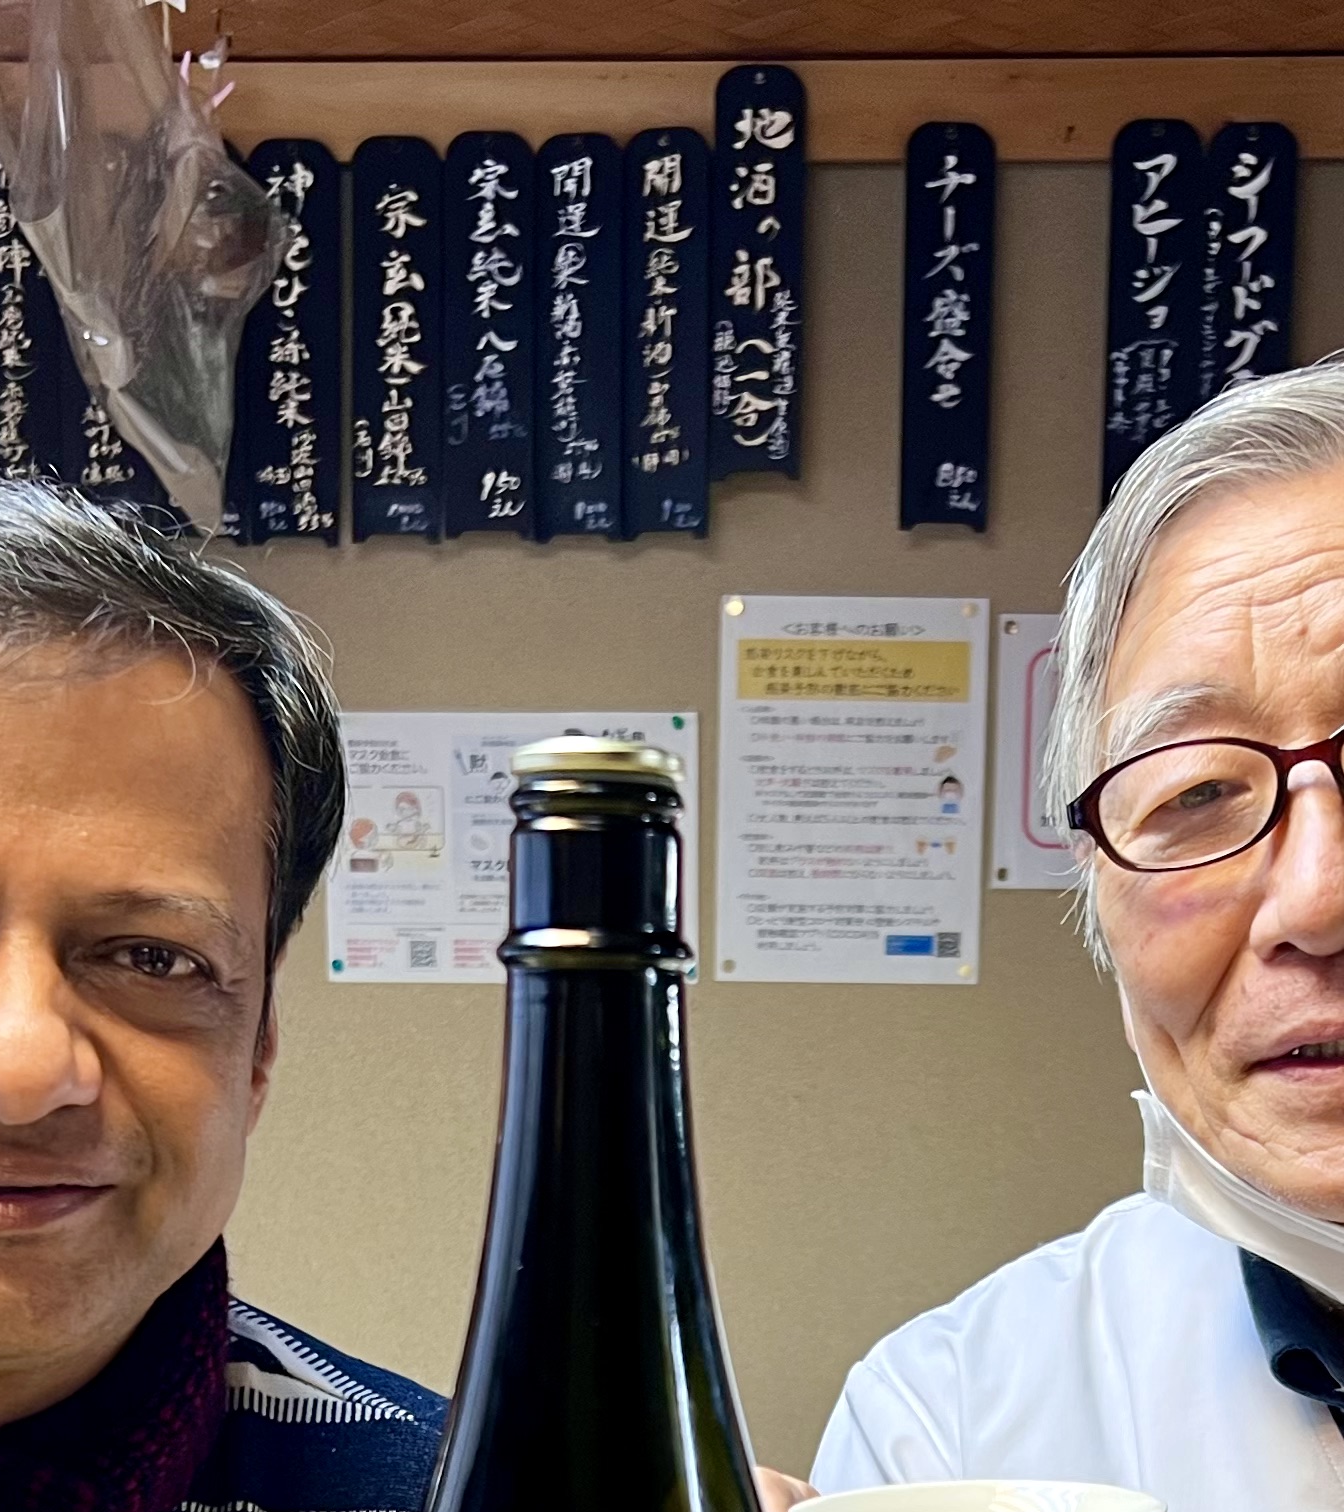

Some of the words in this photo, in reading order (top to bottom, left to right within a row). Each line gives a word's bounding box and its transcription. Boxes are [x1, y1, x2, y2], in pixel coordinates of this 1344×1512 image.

[1131, 153, 1184, 330] アヒージョ
